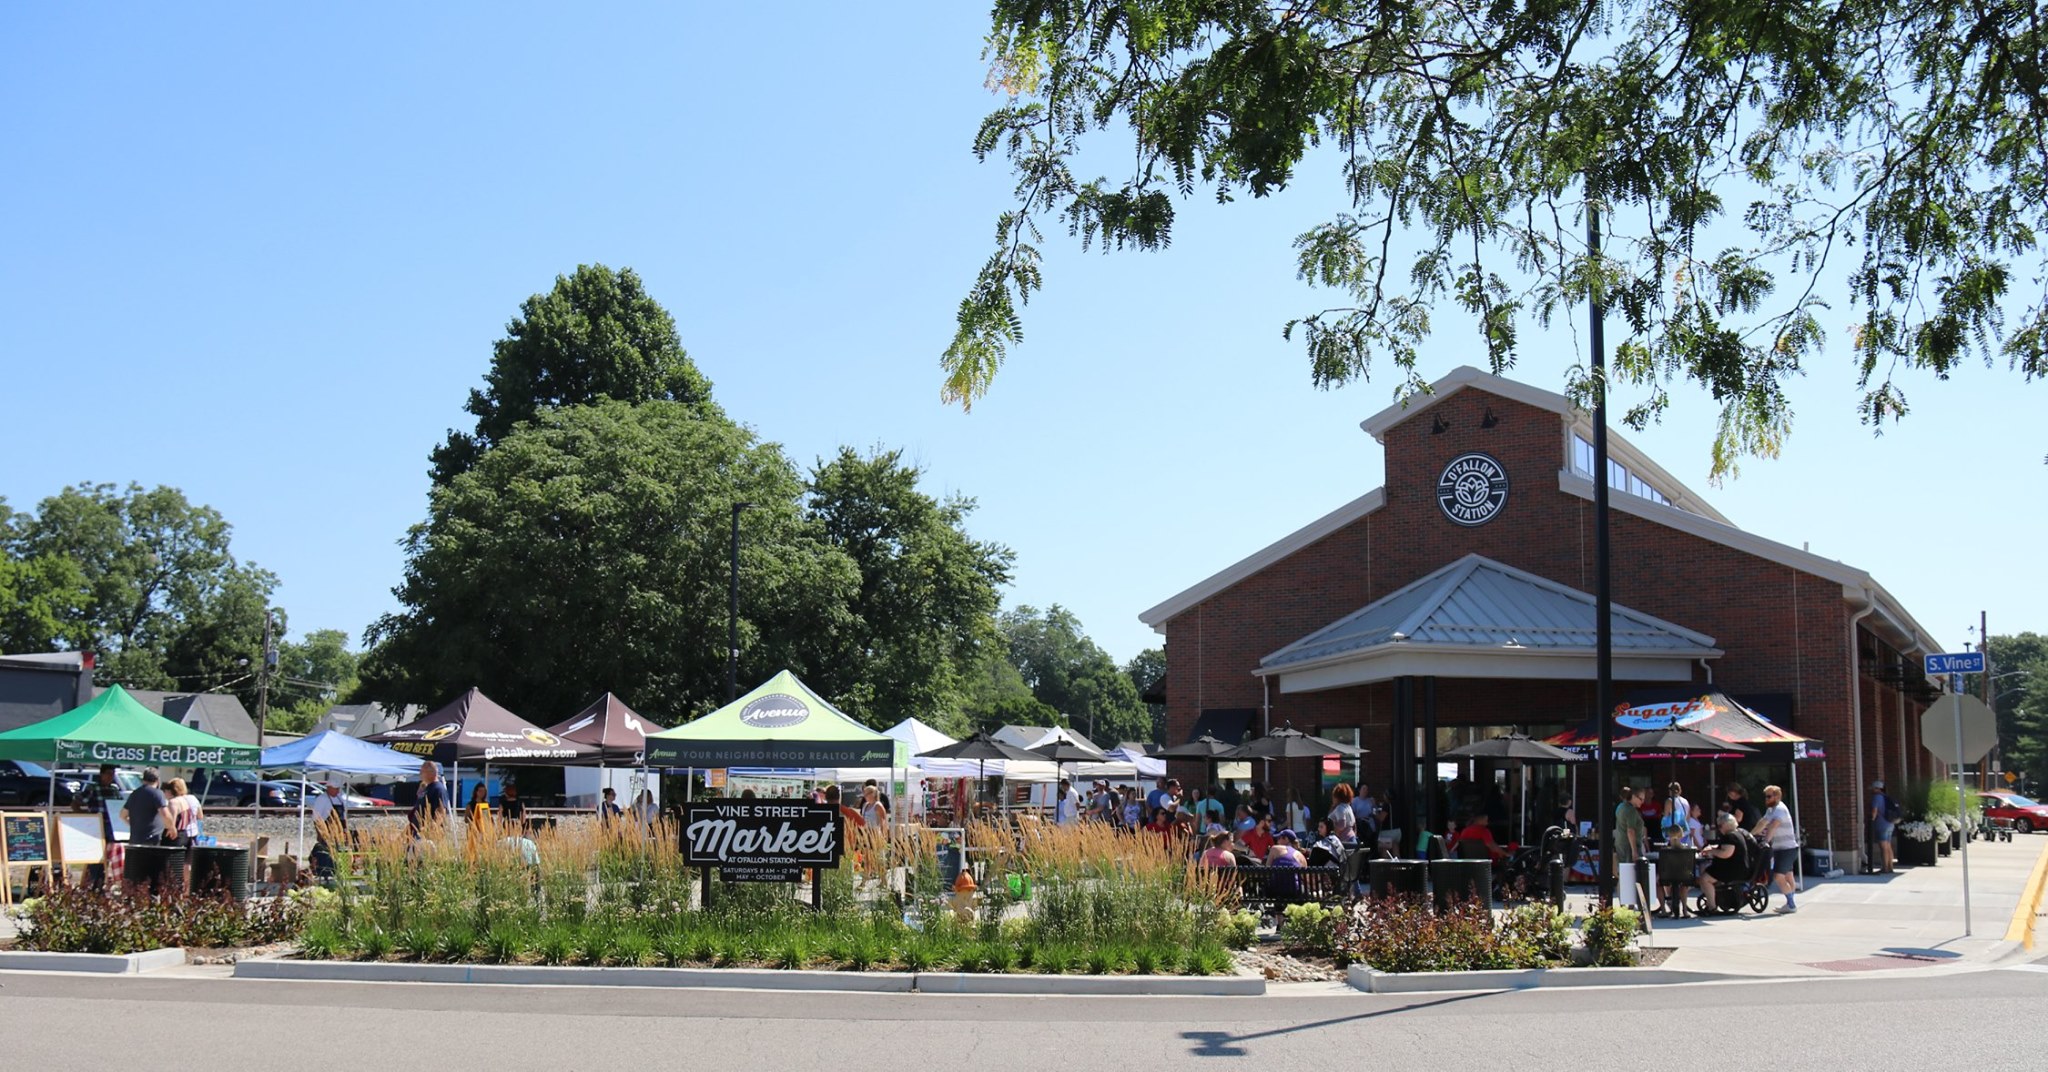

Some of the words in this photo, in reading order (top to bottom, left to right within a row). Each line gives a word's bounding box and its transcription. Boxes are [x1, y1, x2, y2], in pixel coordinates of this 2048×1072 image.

[1448, 460, 1495, 480] O'FALLON
[1452, 500, 1495, 519] STATION
[1929, 657, 1941, 670] S.
[1943, 656, 1972, 670] Vine
[743, 708, 809, 721] Avenue
[67, 751, 86, 759] Beef
[92, 742, 145, 760] Grass
[150, 745, 181, 763] Fed
[186, 747, 225, 764] Beef
[485, 746, 577, 760] globalbrew.com
[649, 748, 677, 759] Avenue
[682, 751, 711, 760] YOUR
[716, 751, 804, 760] NEIGHBORHOOD
[809, 751, 855, 761] REALTOR
[860, 750, 890, 761] Avenue
[716, 806, 750, 817] VINE
[754, 806, 808, 818] STREET
[686, 819, 836, 862] Market
